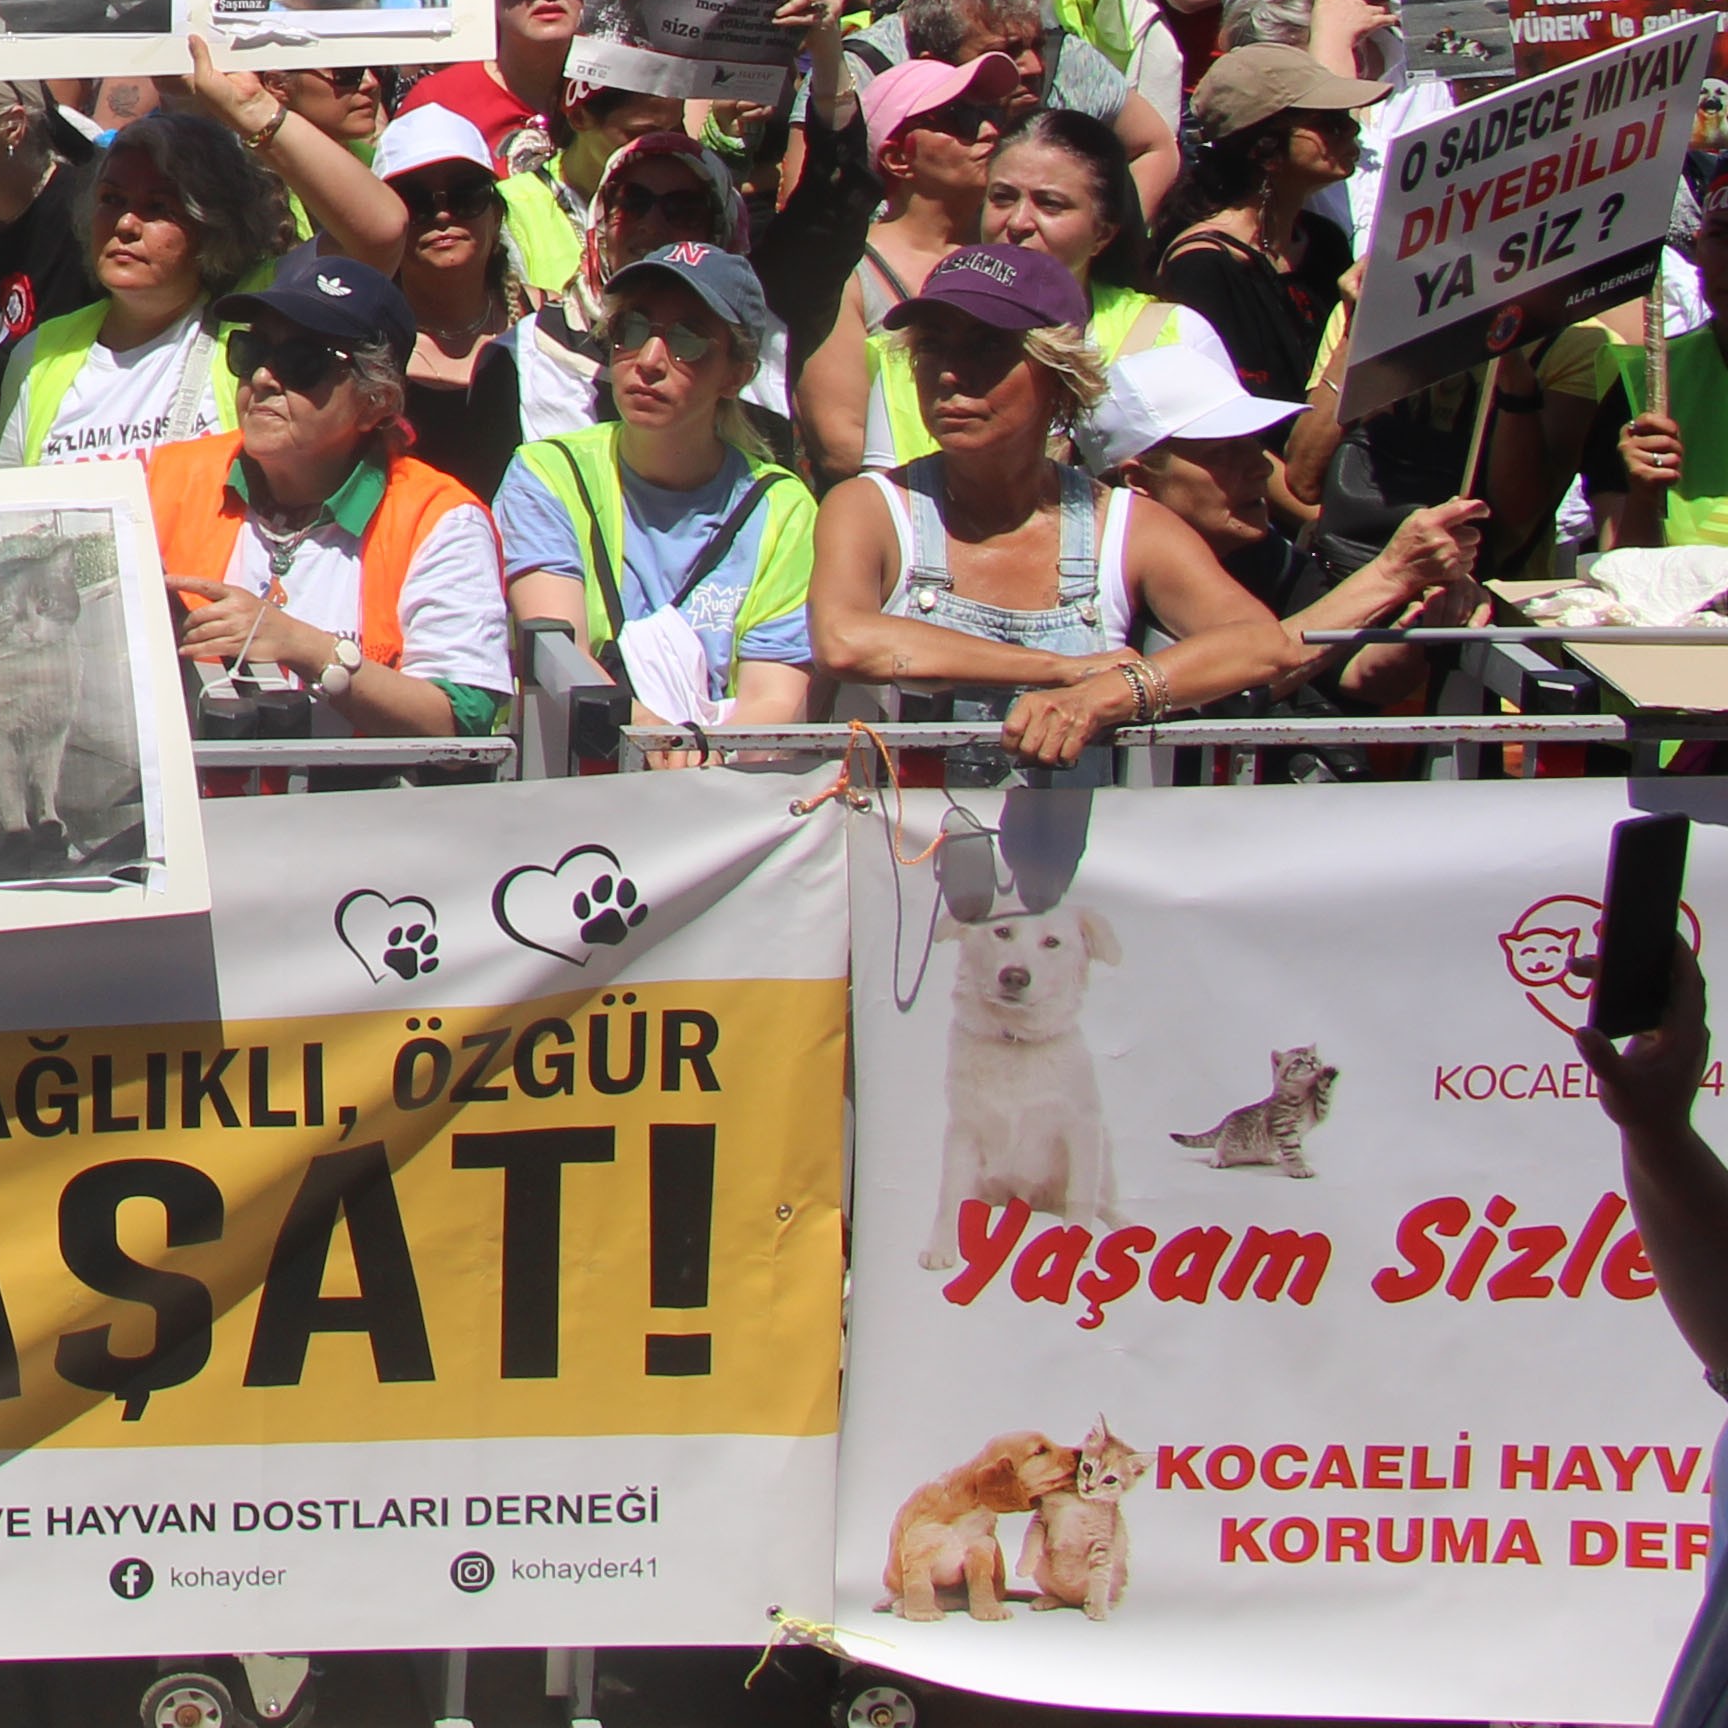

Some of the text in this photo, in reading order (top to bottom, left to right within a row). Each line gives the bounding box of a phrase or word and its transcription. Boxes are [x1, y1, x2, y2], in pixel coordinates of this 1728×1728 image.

[1400, 32, 1700, 193] O SADECE MİYAV
[1396, 101, 1667, 263] DİYEBİLDİ
[1413, 192, 1625, 318] YA SİZ ?
[942, 1197, 1332, 1330] Yaşam
[1156, 1430, 1472, 1491] KOCAELİ
[1219, 1517, 1543, 1566] KORUMA
